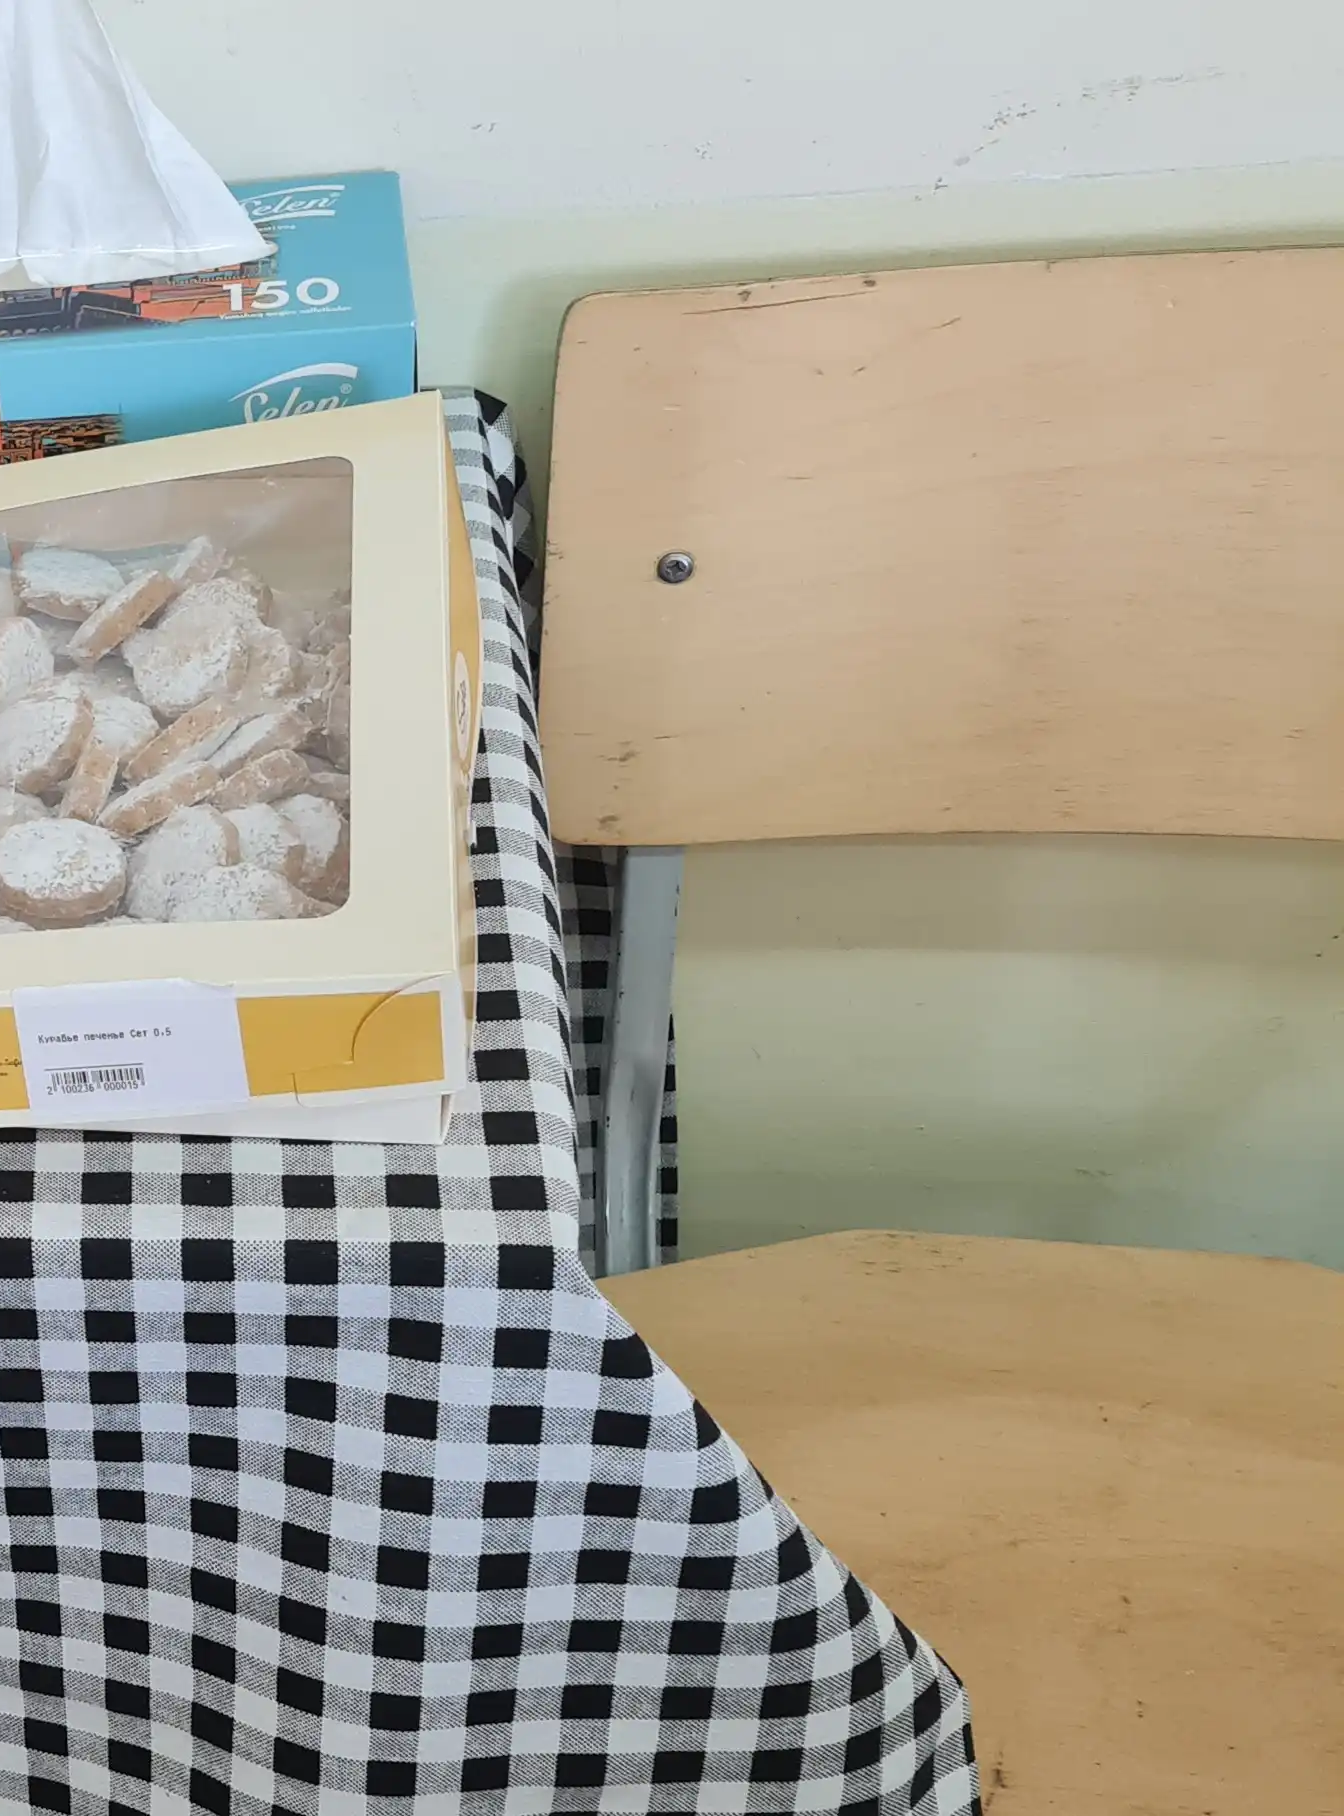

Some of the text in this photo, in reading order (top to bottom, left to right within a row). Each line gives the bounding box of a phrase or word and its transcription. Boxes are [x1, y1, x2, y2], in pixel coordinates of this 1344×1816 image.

[223, 277, 340, 312] 150
[37, 1034, 79, 1045] Курабье
[83, 1031, 125, 1042] печенье
[129, 1028, 148, 1038] Сет
[103, 1079, 140, 1092] 000015
